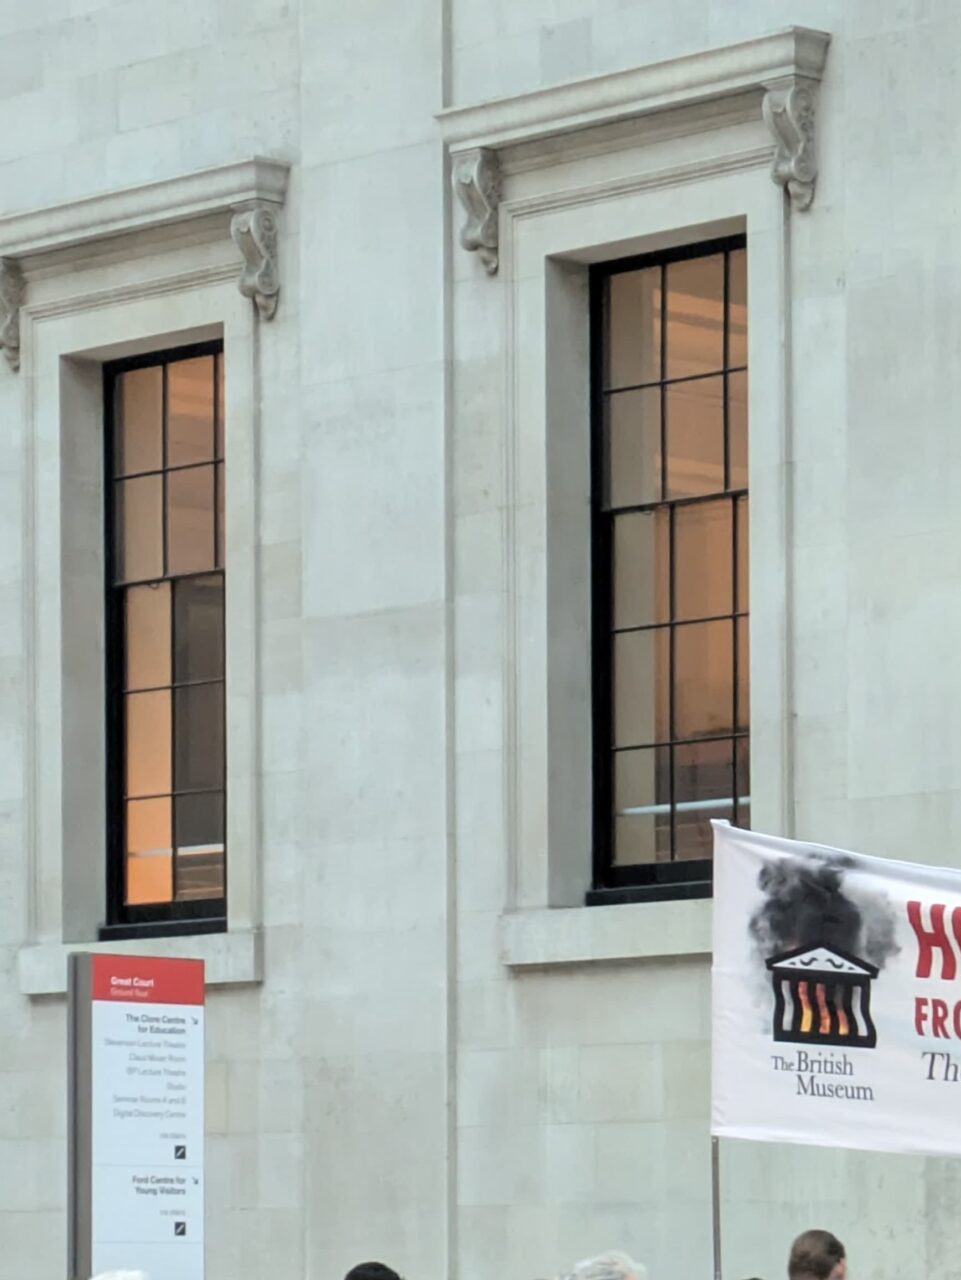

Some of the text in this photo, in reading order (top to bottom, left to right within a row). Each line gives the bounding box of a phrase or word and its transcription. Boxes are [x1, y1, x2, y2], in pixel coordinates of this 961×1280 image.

[110, 976, 154, 988] Great Court
[126, 1013, 139, 1022] The
[161, 1016, 186, 1025] Centre
[137, 1025, 186, 1035] for Education
[771, 1051, 854, 1076] The British
[796, 1073, 875, 1101] Museum
[132, 1176, 186, 1185] Ford Centre for
[135, 1187, 186, 1196] Young Visitors
